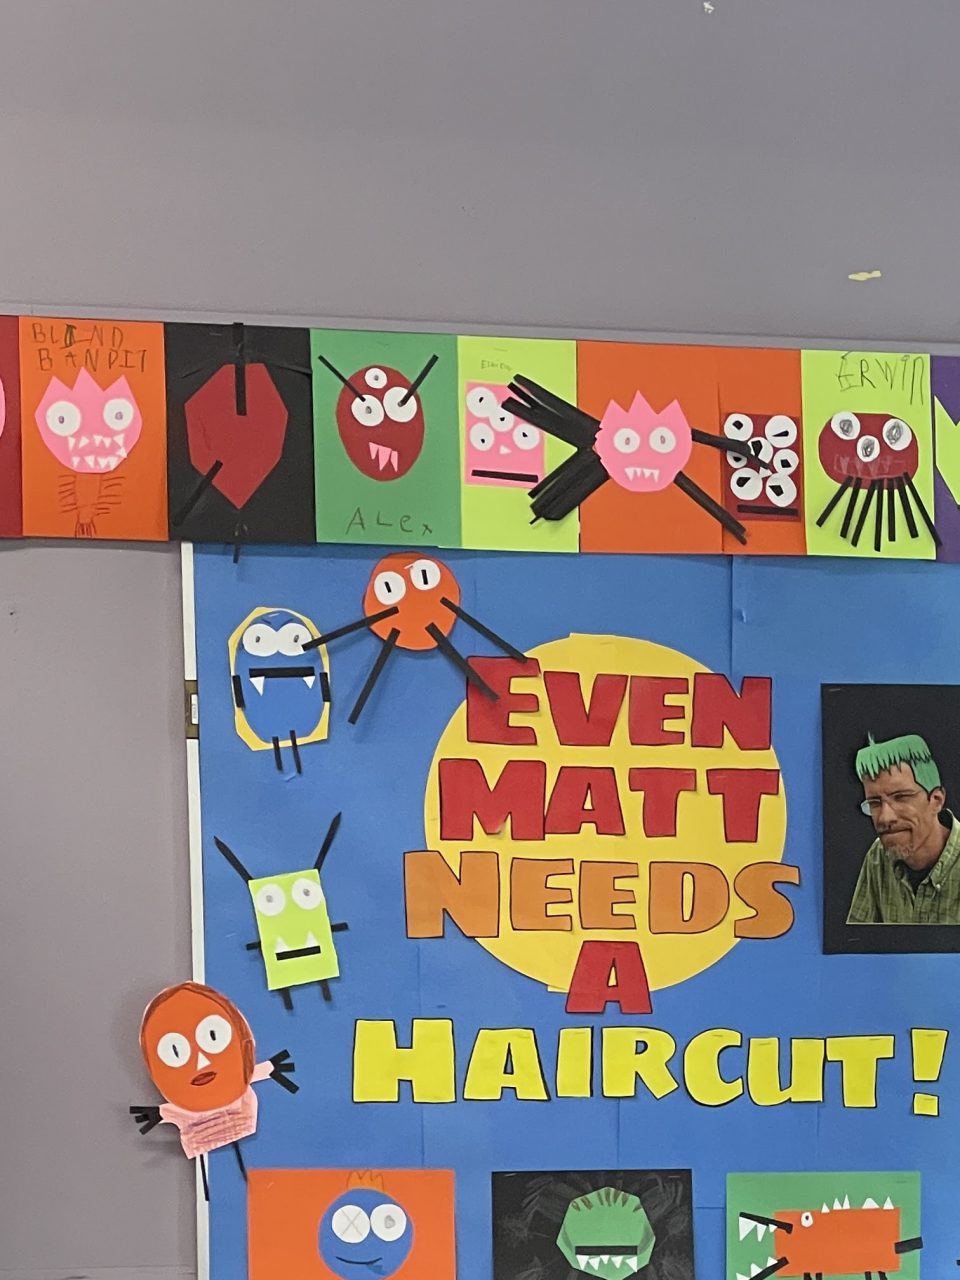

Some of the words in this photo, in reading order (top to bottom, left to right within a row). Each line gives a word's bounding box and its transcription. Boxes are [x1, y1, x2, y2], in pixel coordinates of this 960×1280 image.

[466, 655, 773, 750] EVEN
[438, 758, 781, 843] MATT
[403, 850, 800, 939] NEEDS
[564, 940, 653, 1015] A
[351, 1017, 950, 1117] HAIRCUT!
